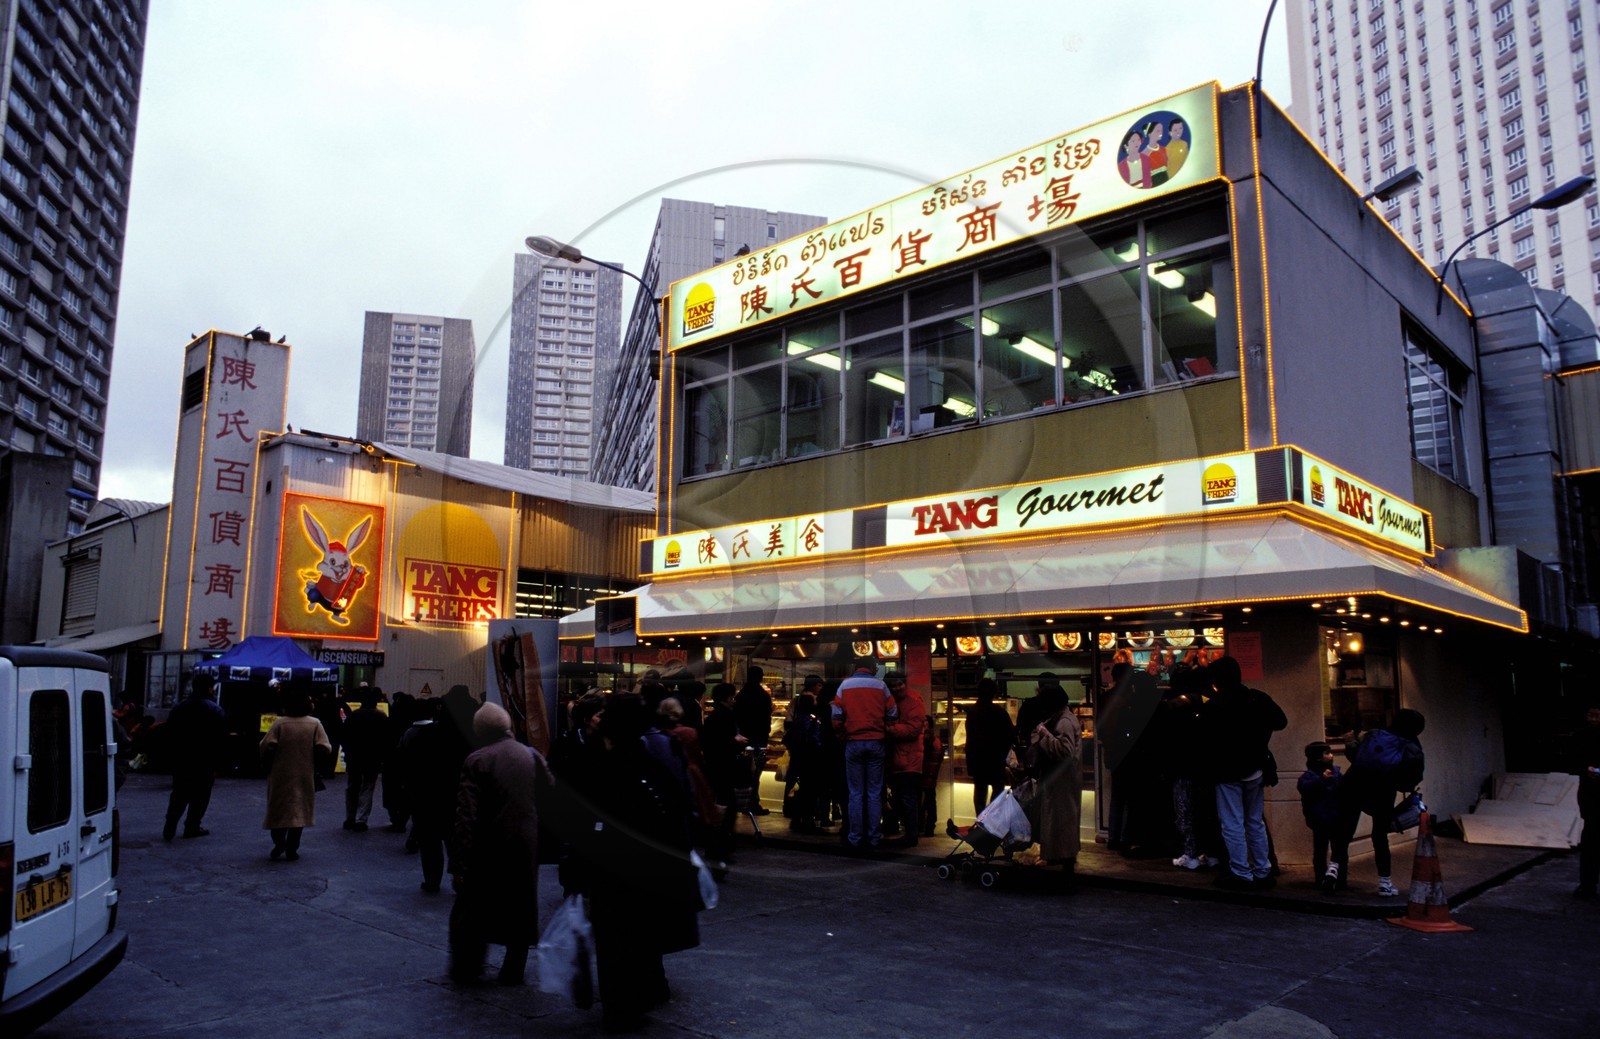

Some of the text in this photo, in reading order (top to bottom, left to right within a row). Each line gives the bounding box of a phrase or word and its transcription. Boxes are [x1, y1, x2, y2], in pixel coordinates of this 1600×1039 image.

[686, 301, 715, 320] TANG
[1207, 478, 1236, 490] TANG
[911, 473, 1165, 536] TANG Gourmet
[1334, 476, 1374, 525] TANG
[1379, 498, 1422, 539] Gourmet
[697, 517, 824, 564] 陳氏美食
[410, 561, 498, 599] TANG
[410, 592, 497, 622] FRERES
[20, 889, 37, 915] 138
[60, 876, 69, 898] 75
